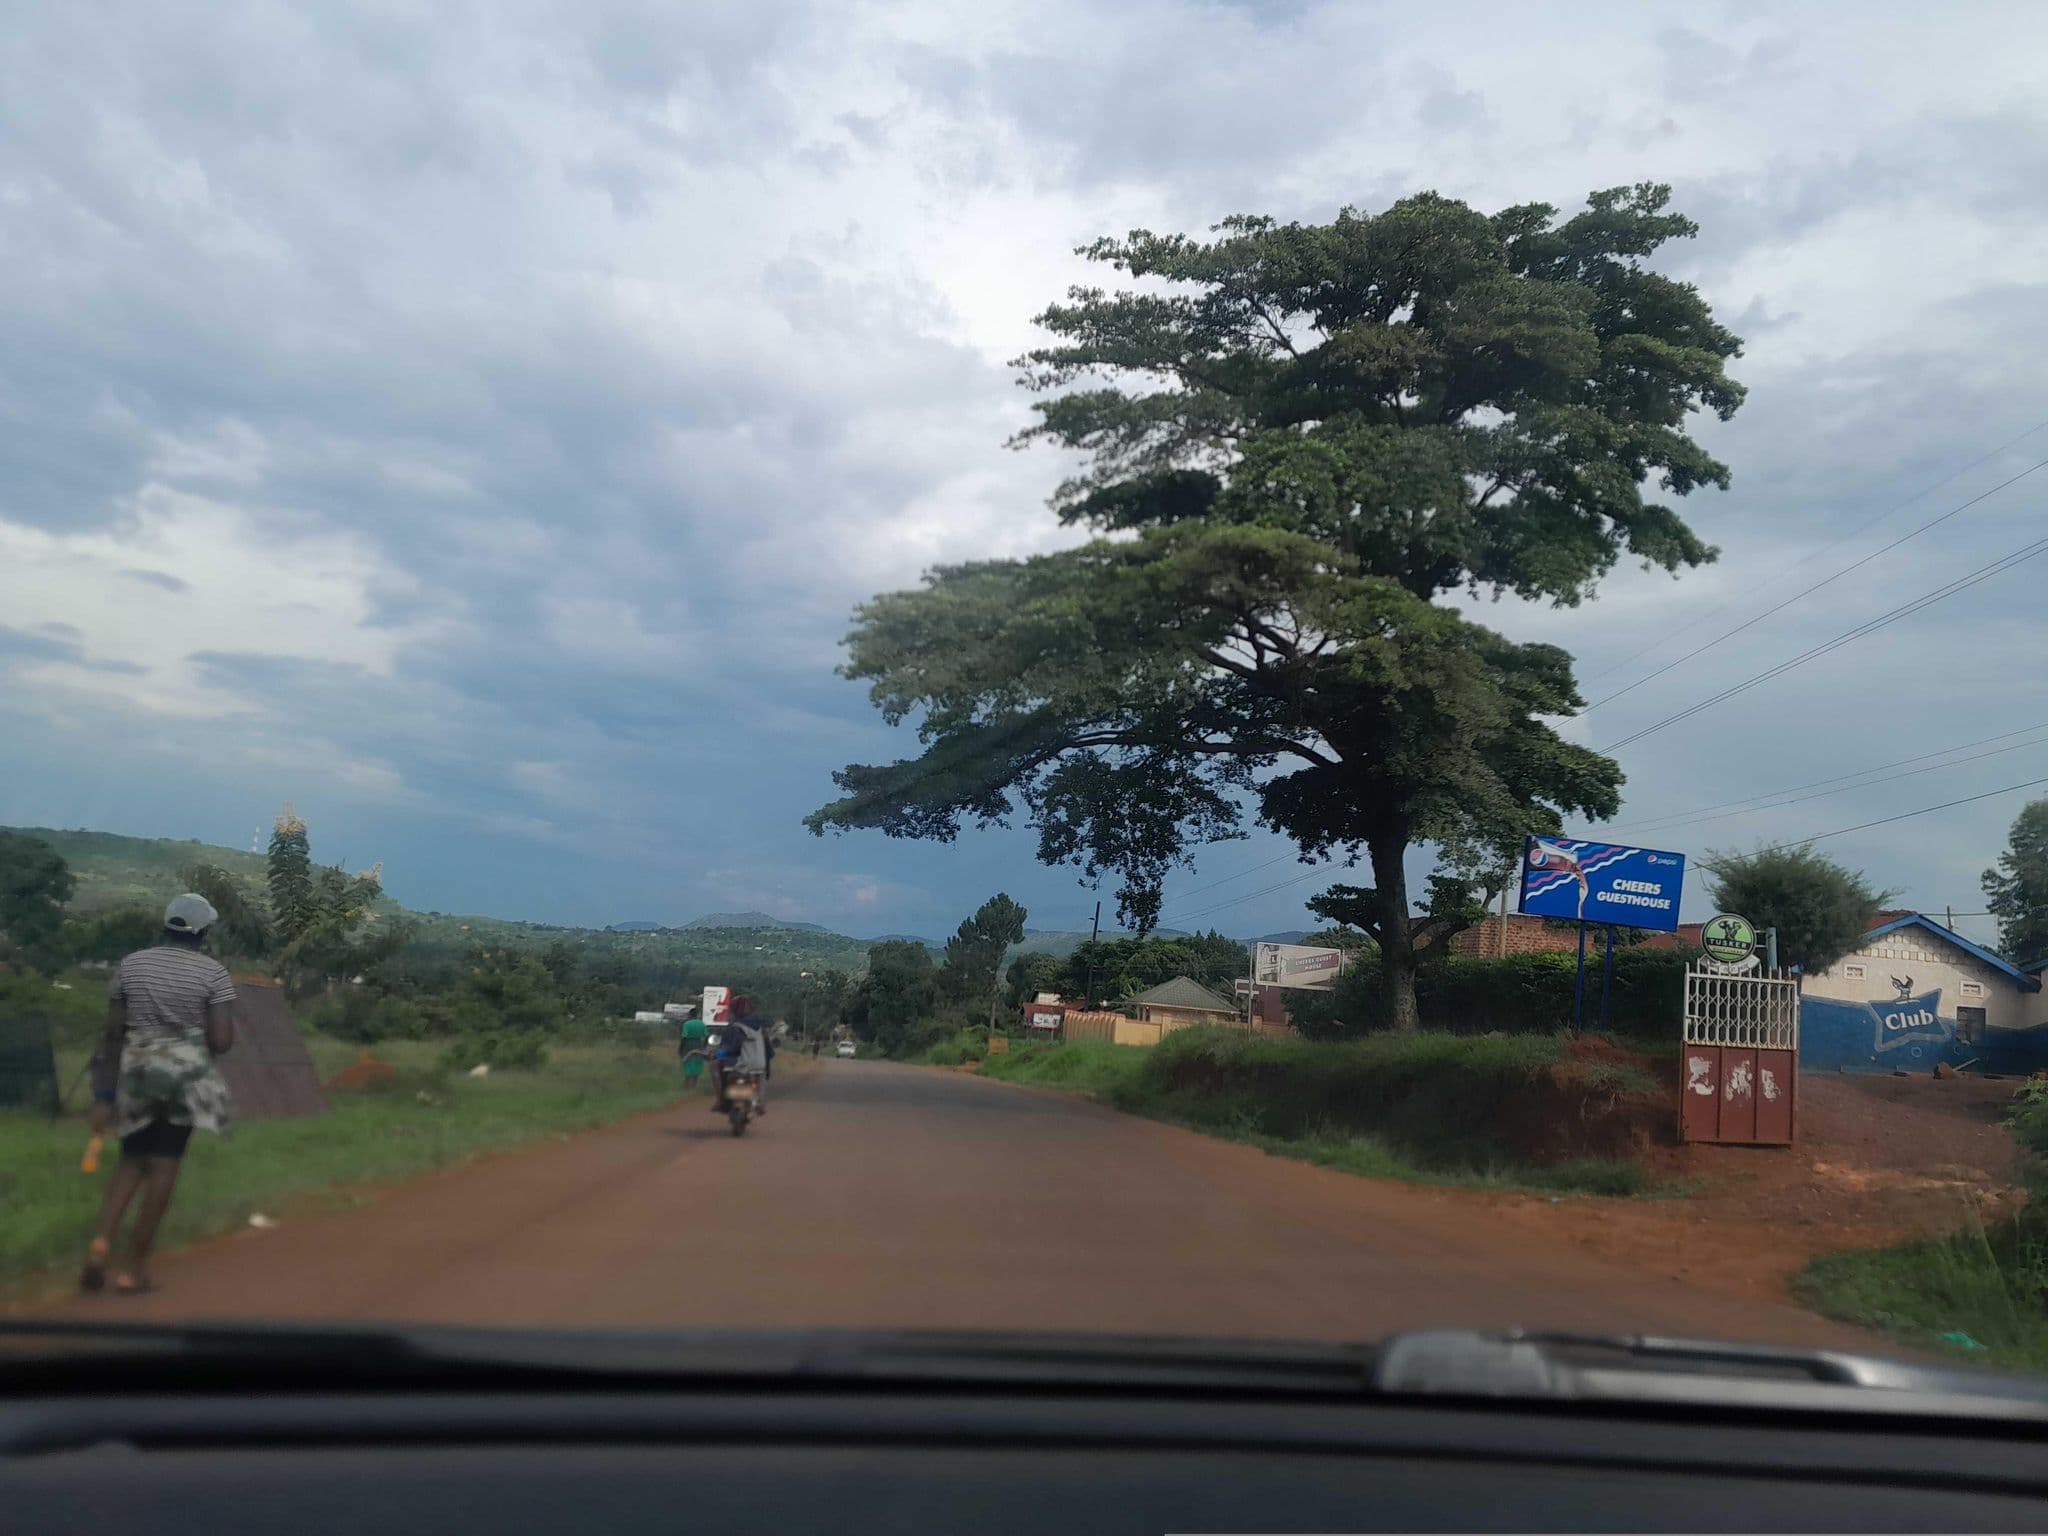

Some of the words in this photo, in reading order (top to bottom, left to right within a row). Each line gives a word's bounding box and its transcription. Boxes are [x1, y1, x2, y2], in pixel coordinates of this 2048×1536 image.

[1612, 879, 1662, 895] CHEERS
[1597, 891, 1671, 909] GUESTHOUSE
[1711, 939, 1747, 948] TUSKER
[1885, 1008, 1934, 1030] Club
